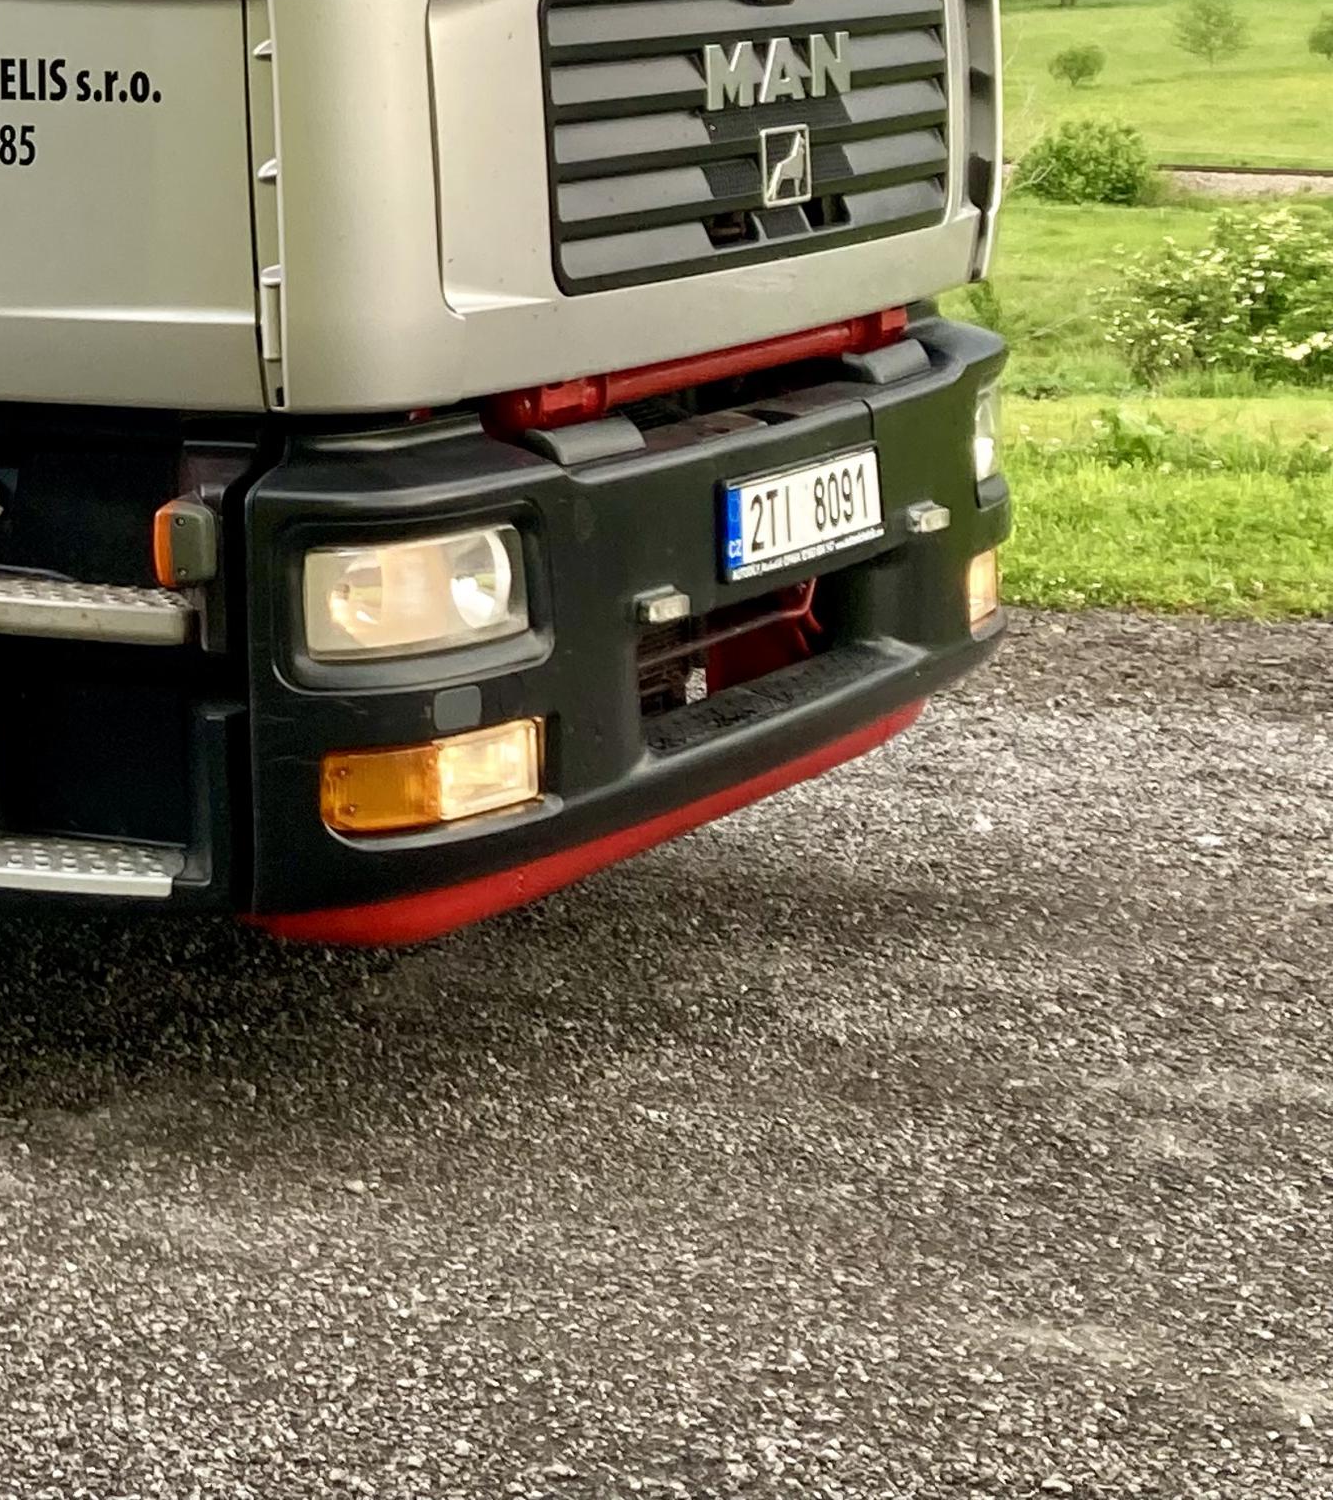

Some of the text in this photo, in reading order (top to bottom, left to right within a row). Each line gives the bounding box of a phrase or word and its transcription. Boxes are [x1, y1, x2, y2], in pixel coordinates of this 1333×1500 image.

[0, 58, 68, 102] ELIS
[75, 69, 162, 104] s.r.o.
[704, 31, 851, 111] MAN
[813, 464, 869, 532] 8091
[728, 539, 743, 559] CZ
